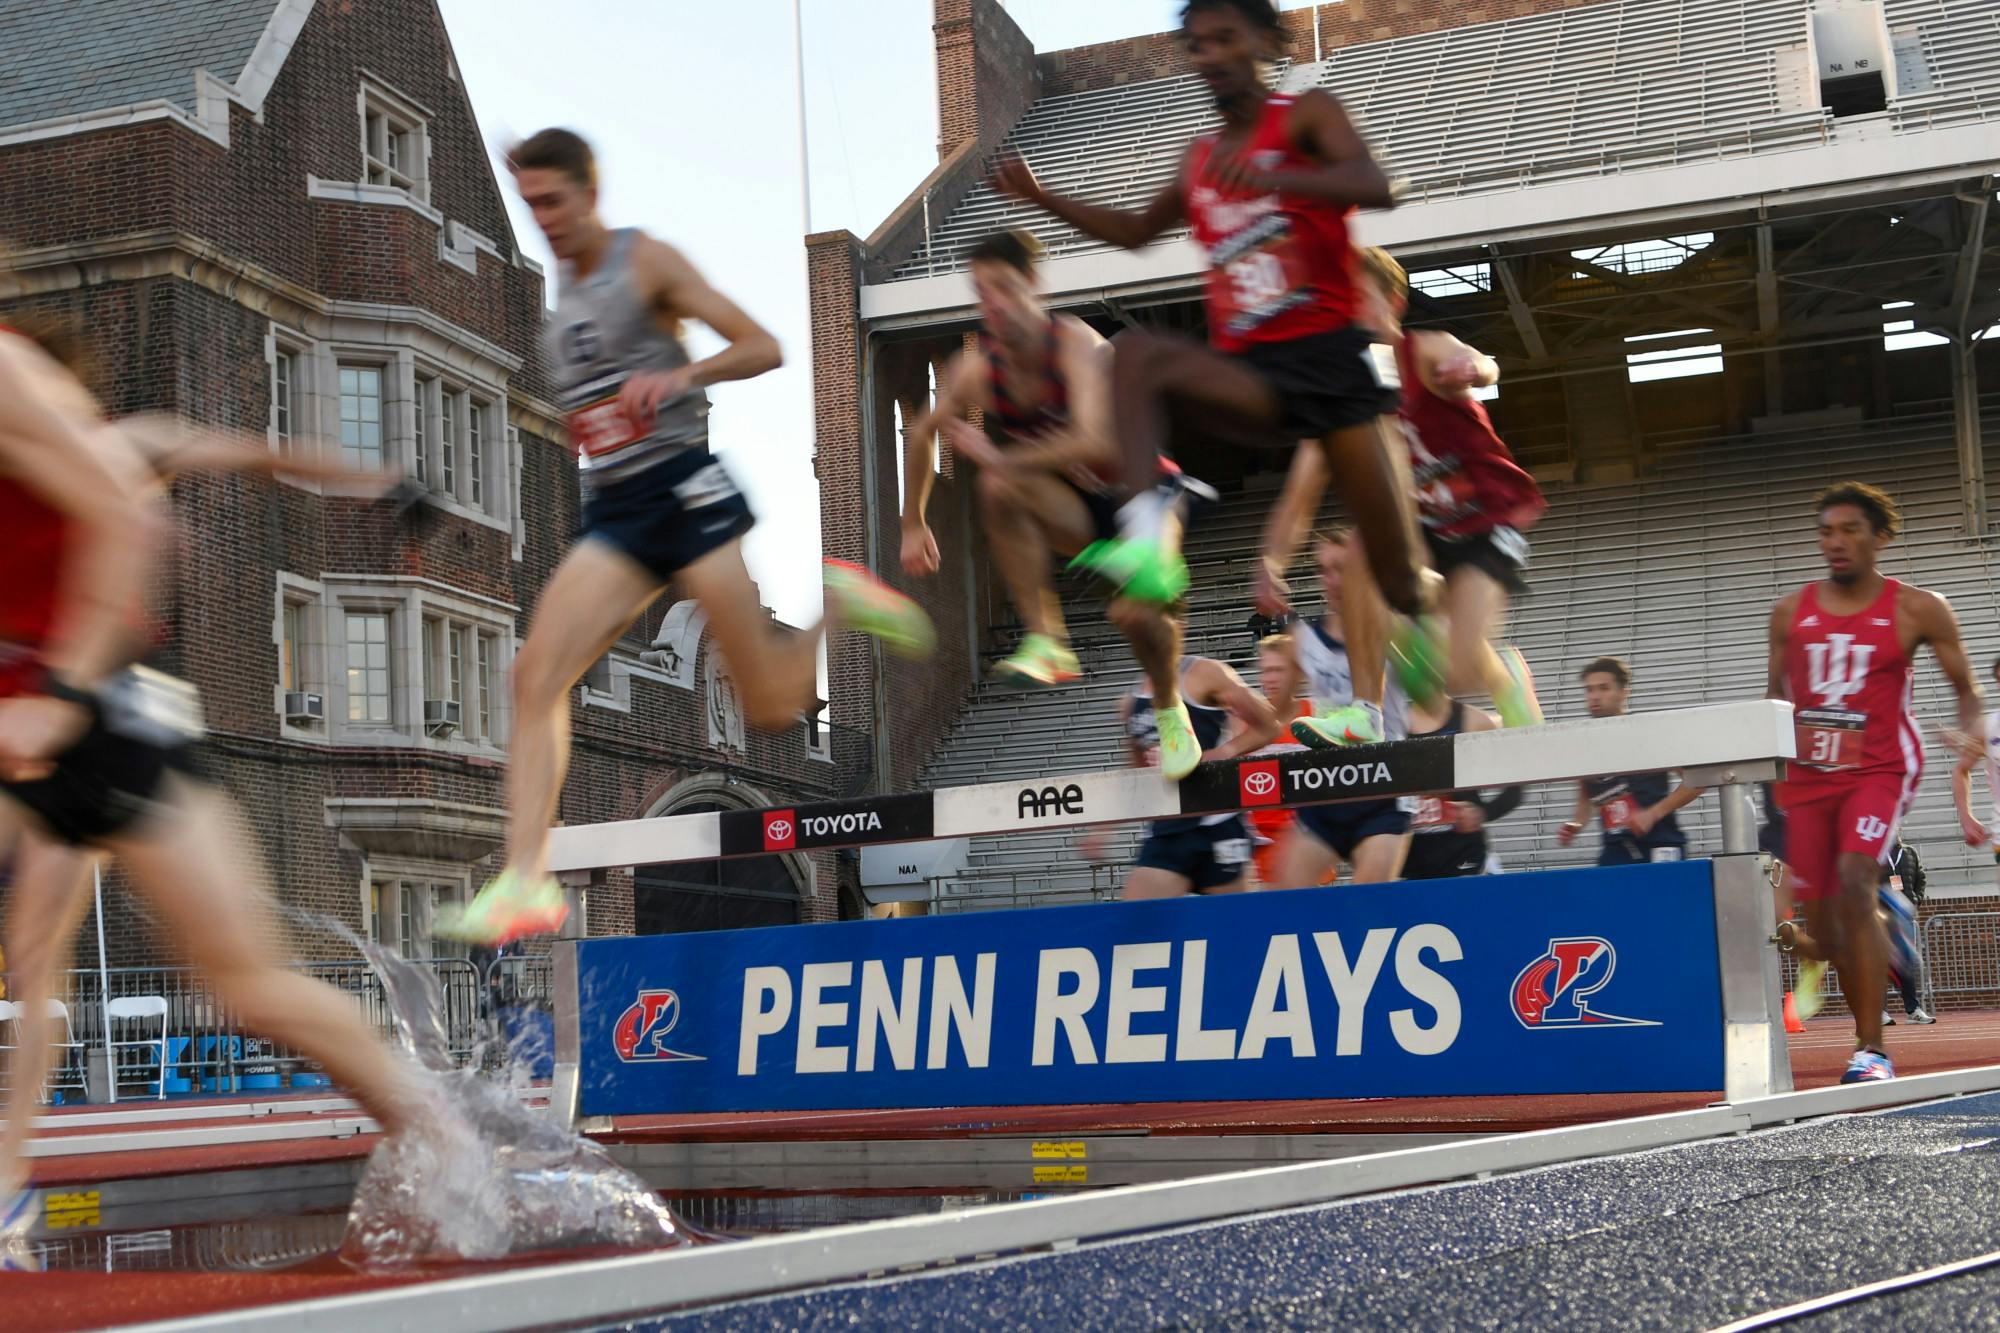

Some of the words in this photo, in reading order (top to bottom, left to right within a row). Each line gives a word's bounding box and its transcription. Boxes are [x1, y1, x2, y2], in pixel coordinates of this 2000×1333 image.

[1829, 63, 1844, 73] NA
[1811, 731, 1842, 762] 31
[1288, 761, 1393, 791] TOYOTA
[801, 811, 882, 836] TOYOTA
[898, 864, 918, 875] NAA
[737, 952, 997, 1076] PENN
[1031, 923, 1464, 1067] RELAYS
